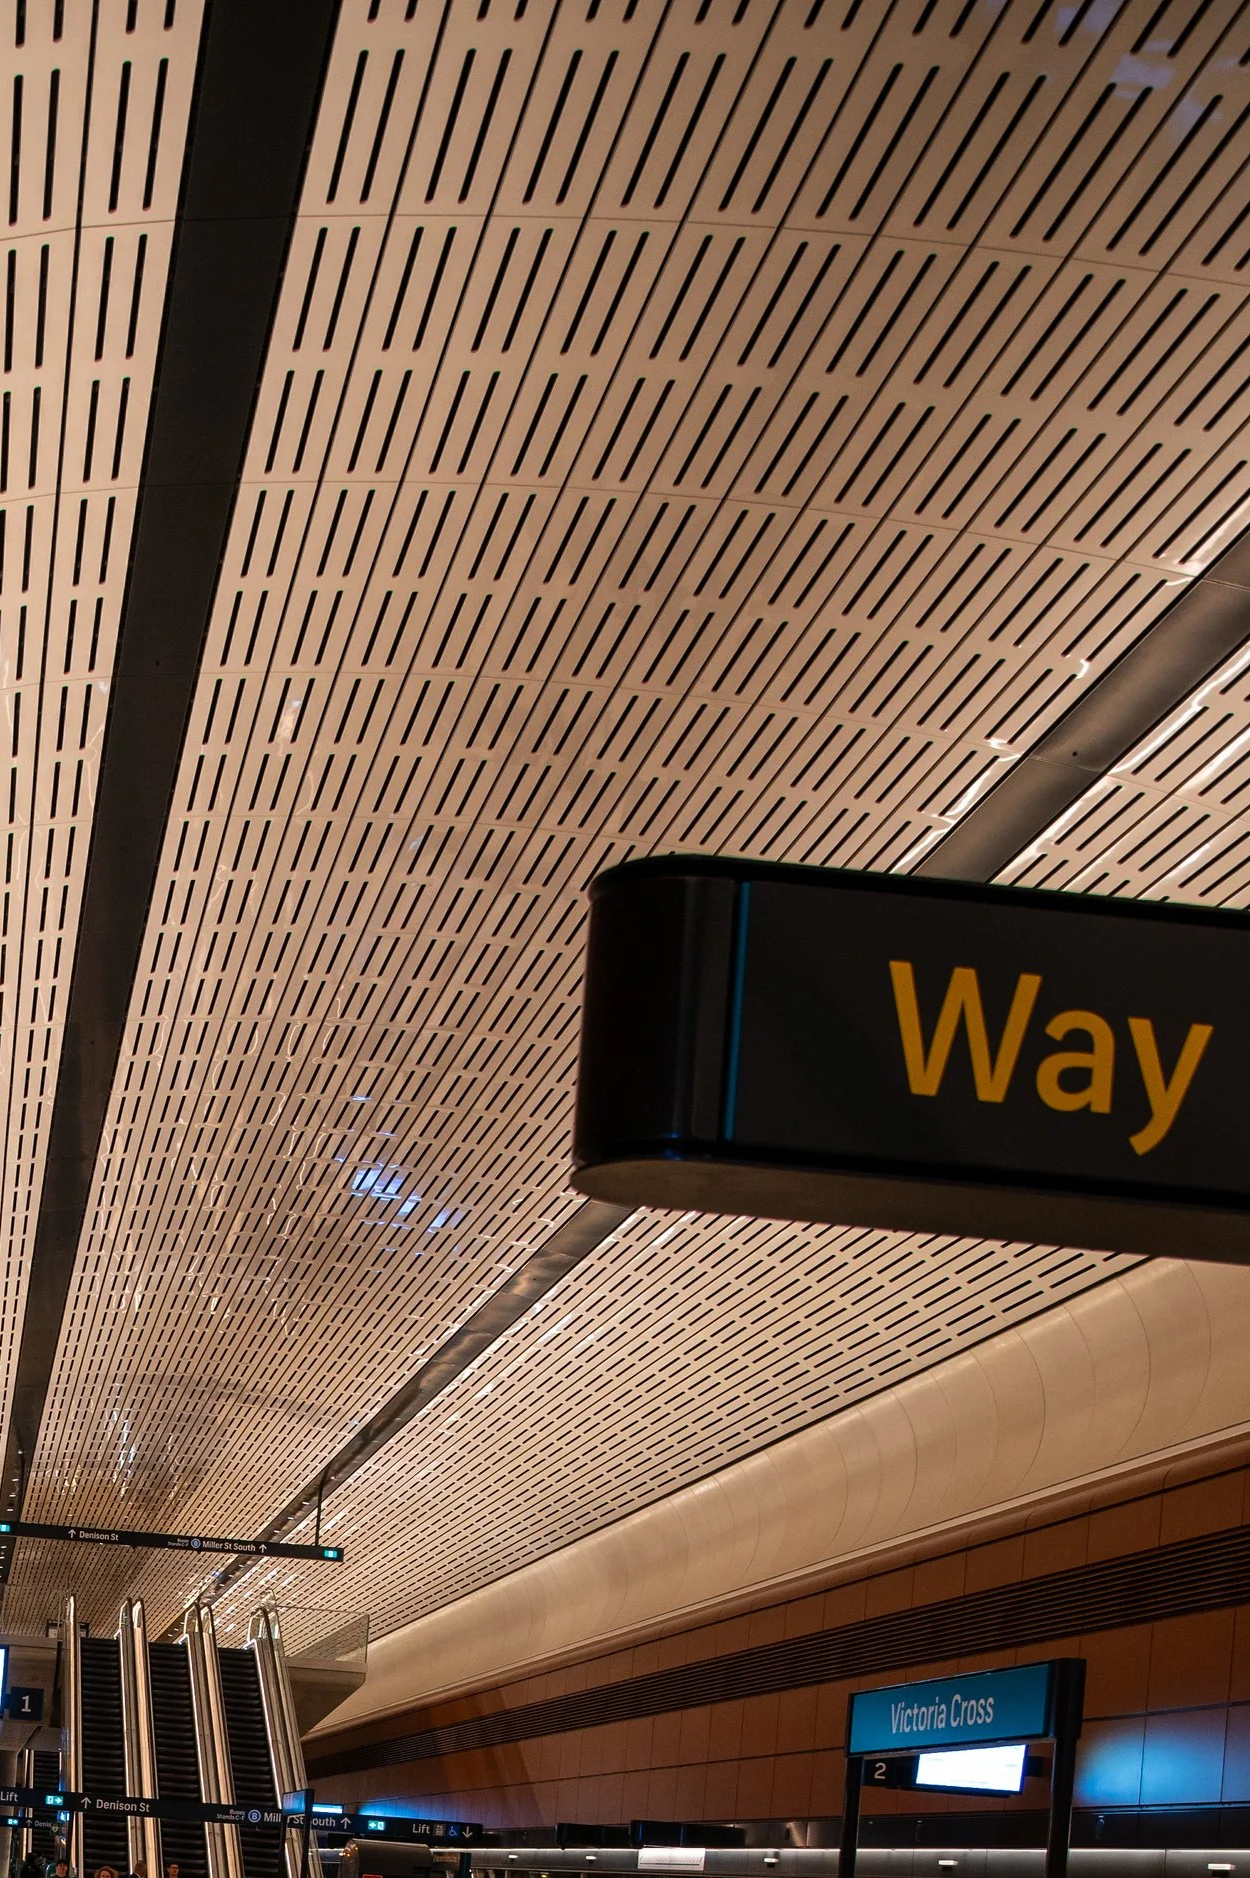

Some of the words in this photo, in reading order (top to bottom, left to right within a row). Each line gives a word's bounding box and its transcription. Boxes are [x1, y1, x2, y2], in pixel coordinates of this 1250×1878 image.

[889, 960, 1214, 1157] Way
[79, 1530, 109, 1541] Denison
[110, 1533, 119, 1542] St
[203, 1540, 223, 1550] Miller
[224, 1542, 232, 1550] St
[233, 1543, 256, 1552] South
[21, 1695, 31, 1712] 1
[891, 1696, 947, 1734] Victoria
[950, 1694, 994, 1728] Cross
[874, 1762, 887, 1780] 2
[0, 1791, 19, 1802] Lift
[96, 1799, 138, 1812] Denison
[139, 1801, 150, 1813] St
[34, 1819, 52, 1828] Denis
[264, 1811, 292, 1824] Millr
[293, 1815, 304, 1825] St
[312, 1816, 336, 1827] outh
[412, 1823, 430, 1834] Lift
